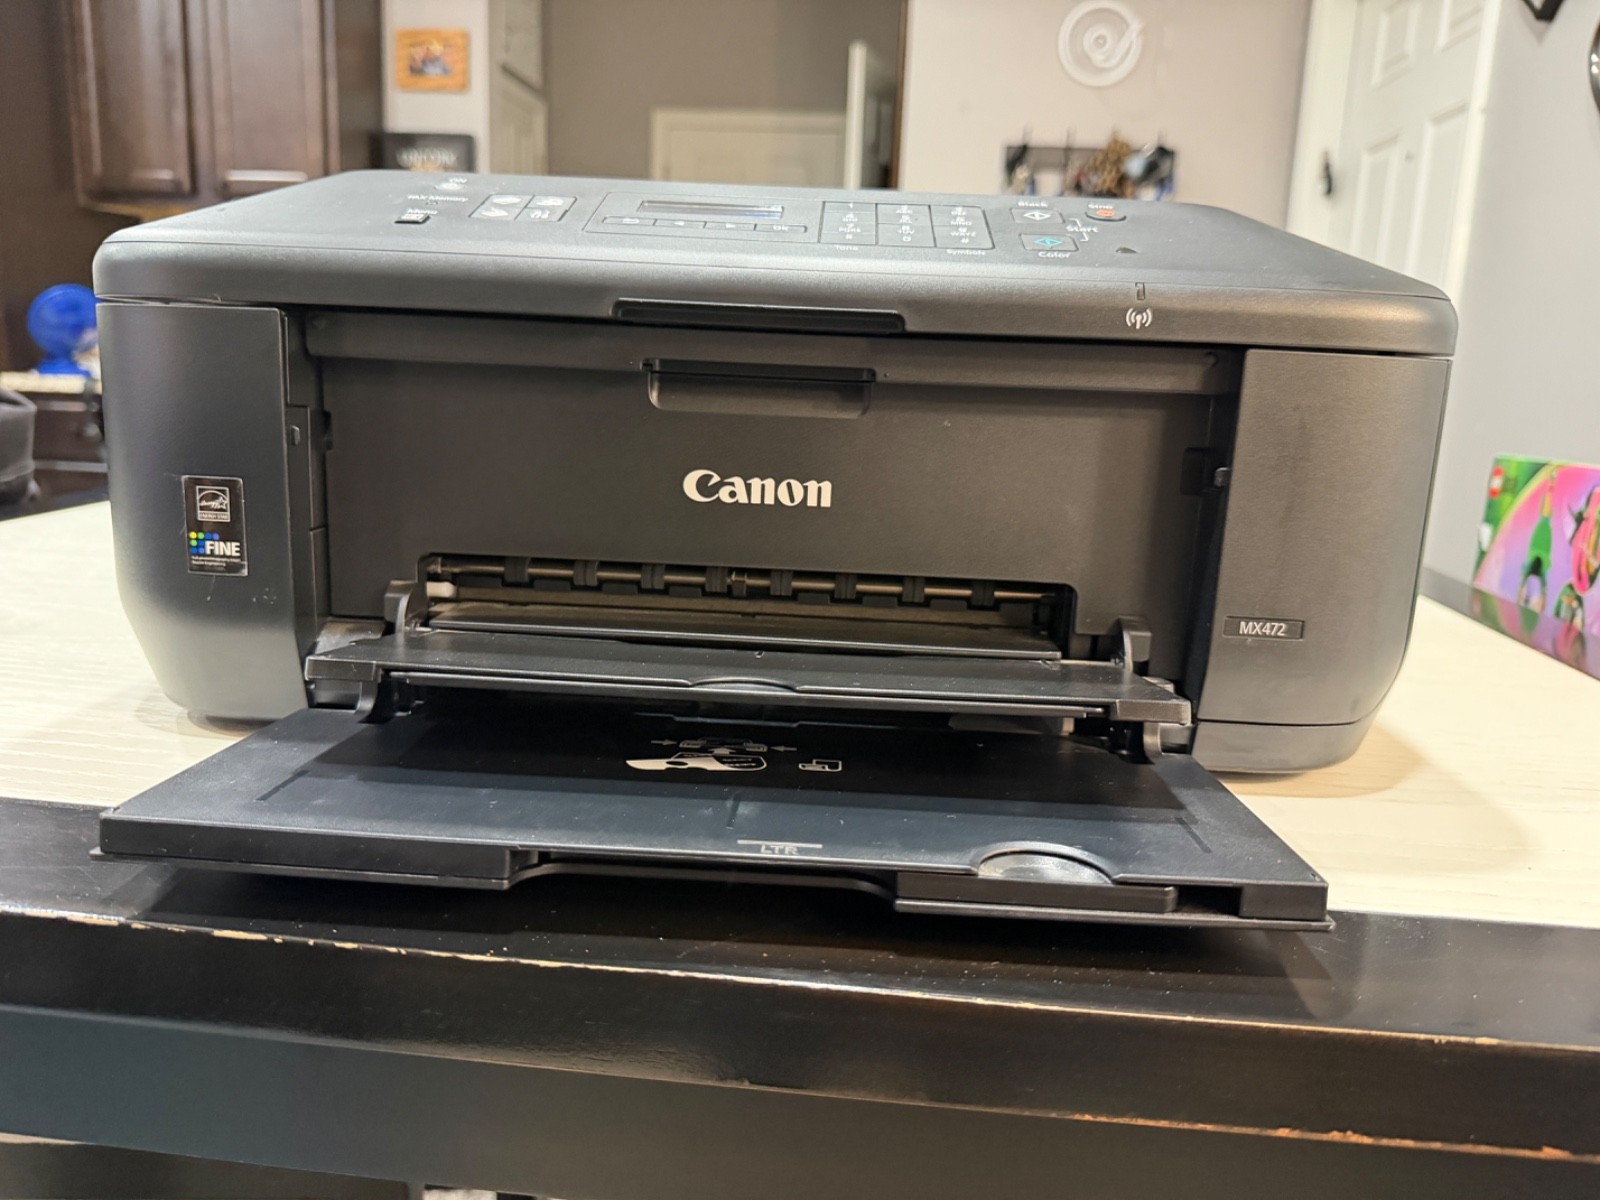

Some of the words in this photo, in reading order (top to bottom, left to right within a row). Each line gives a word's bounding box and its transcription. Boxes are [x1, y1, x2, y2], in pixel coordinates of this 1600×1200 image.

[1038, 251, 1071, 259] Color
[682, 469, 832, 508] Canon
[205, 540, 241, 557] FINE
[1239, 621, 1287, 637] MX472
[760, 844, 799, 856] LTR
